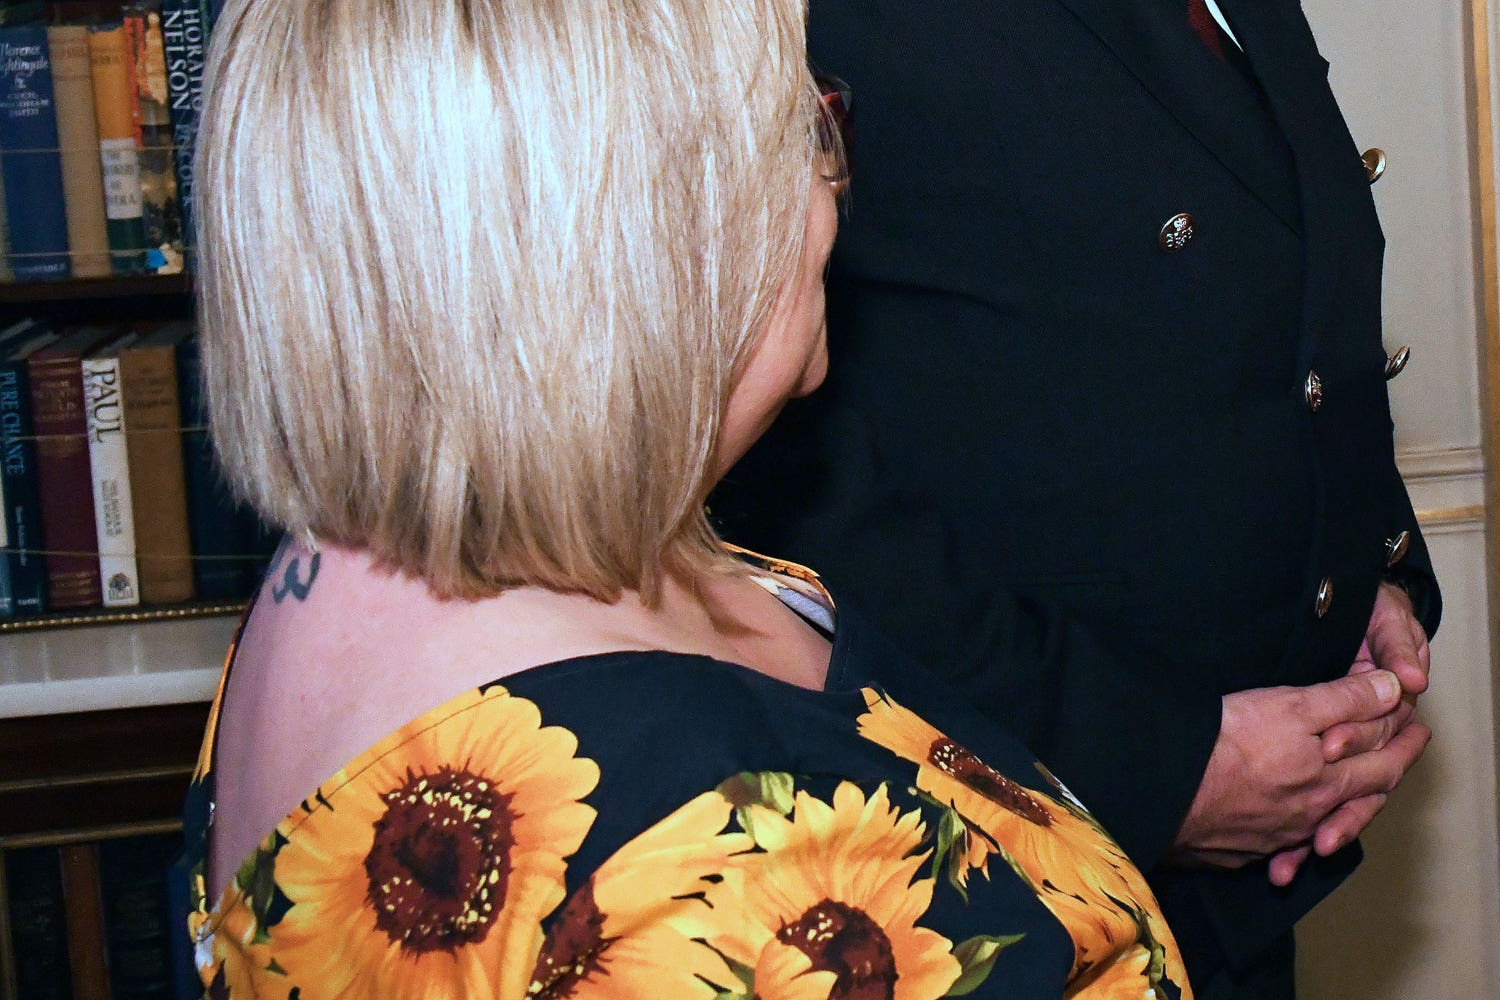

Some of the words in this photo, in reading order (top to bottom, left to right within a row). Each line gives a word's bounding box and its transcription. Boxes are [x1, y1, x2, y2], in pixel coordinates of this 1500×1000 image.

[163, 10, 191, 110] NELSON
[183, 9, 206, 111] HORATIO
[0, 371, 19, 412] PURE
[91, 369, 121, 443] PAUL
[4, 414, 25, 475] CHANCE
